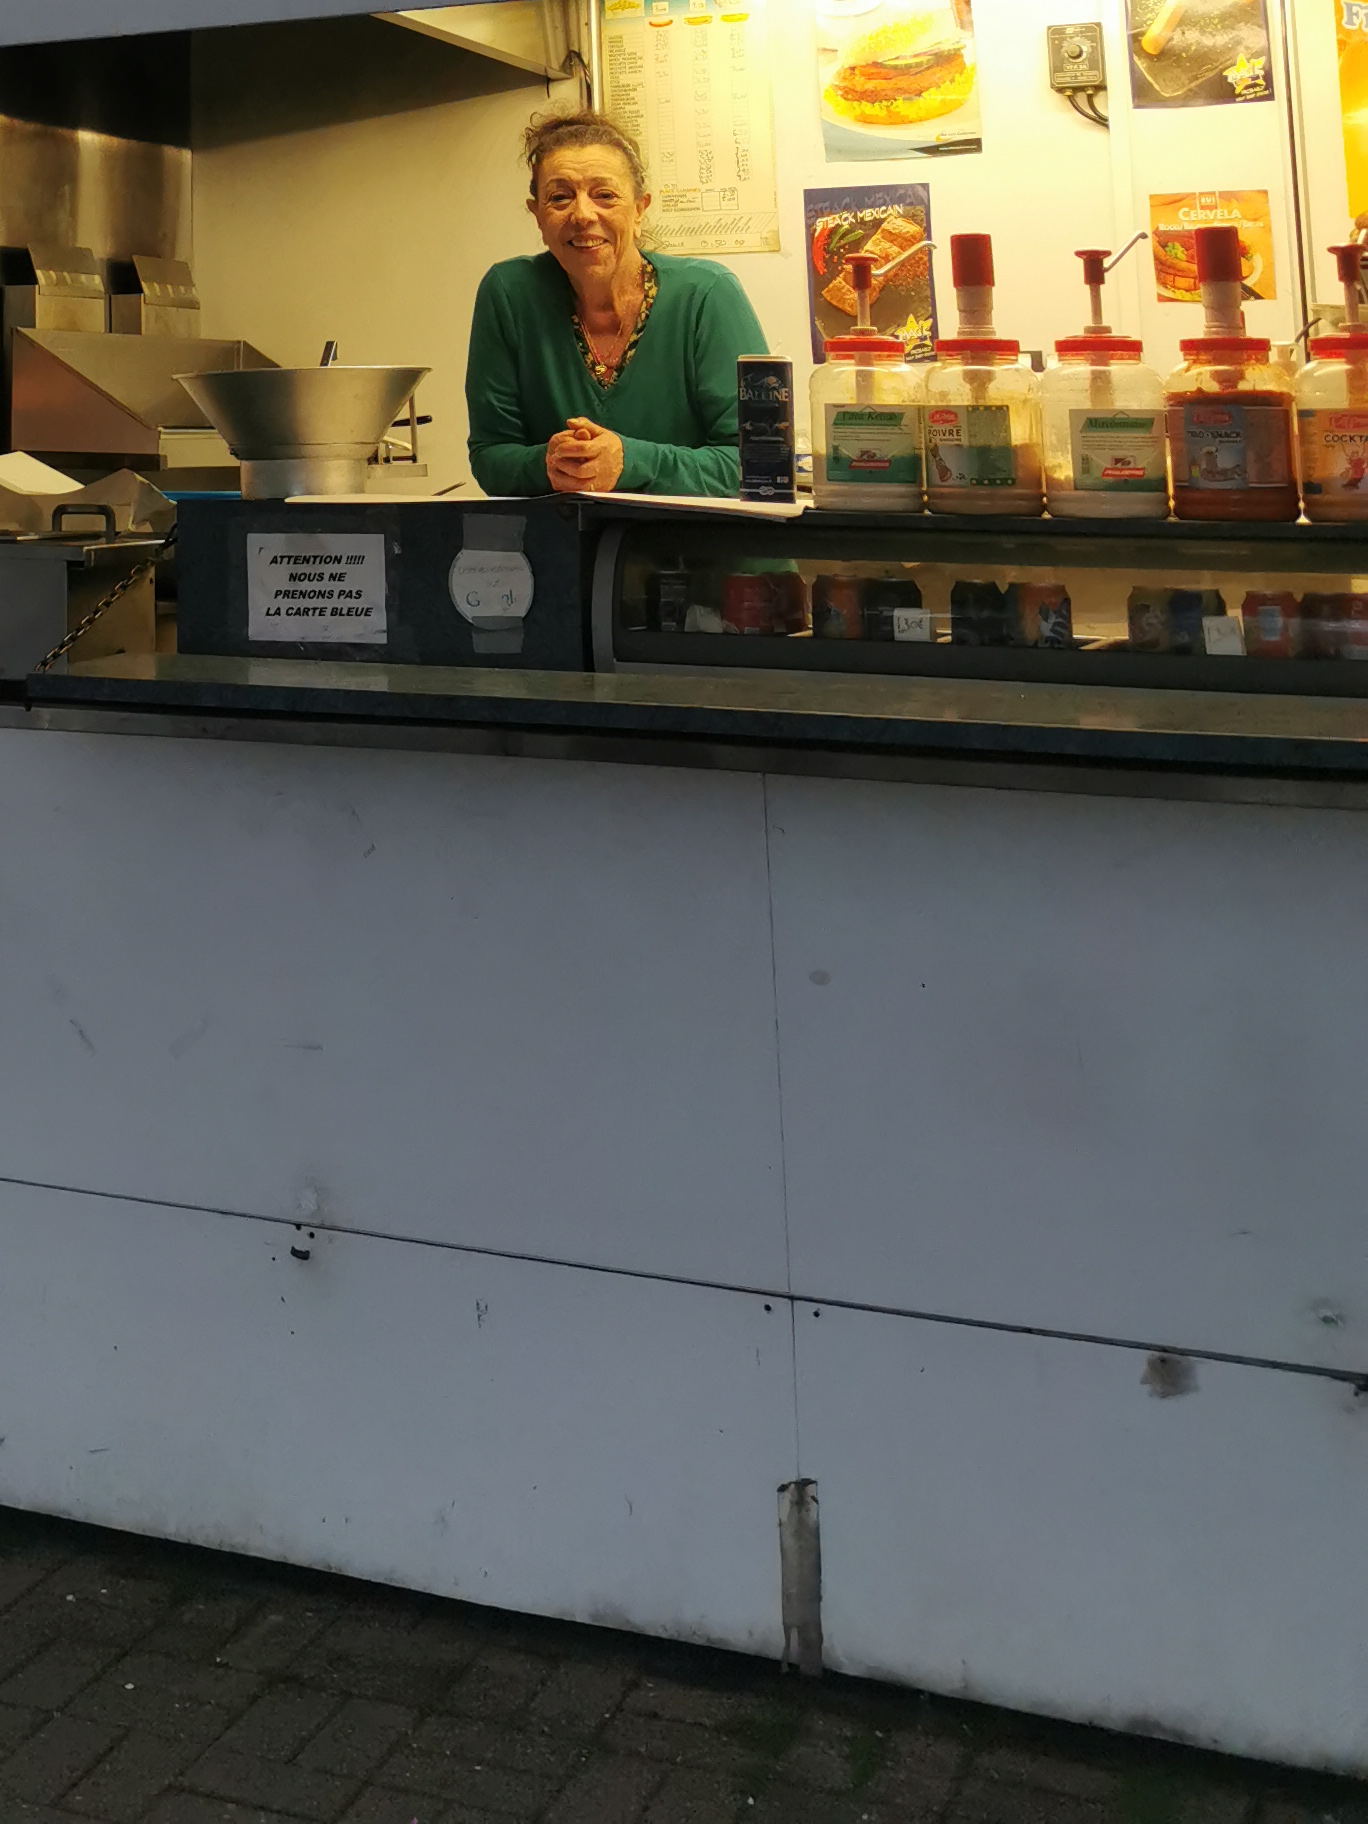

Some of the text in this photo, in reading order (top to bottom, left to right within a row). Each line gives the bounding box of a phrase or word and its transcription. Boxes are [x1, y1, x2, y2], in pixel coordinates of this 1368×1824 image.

[815, 203, 904, 230] STEACK MEXICAIN
[1178, 207, 1242, 221] CERVELA
[928, 428, 962, 438] POIVRE
[269, 555, 343, 565] ATTENTION
[288, 572, 346, 582] NOUS NE
[273, 589, 363, 600] PRENONS PAS
[265, 607, 373, 617] LA CARTE BLEUE
